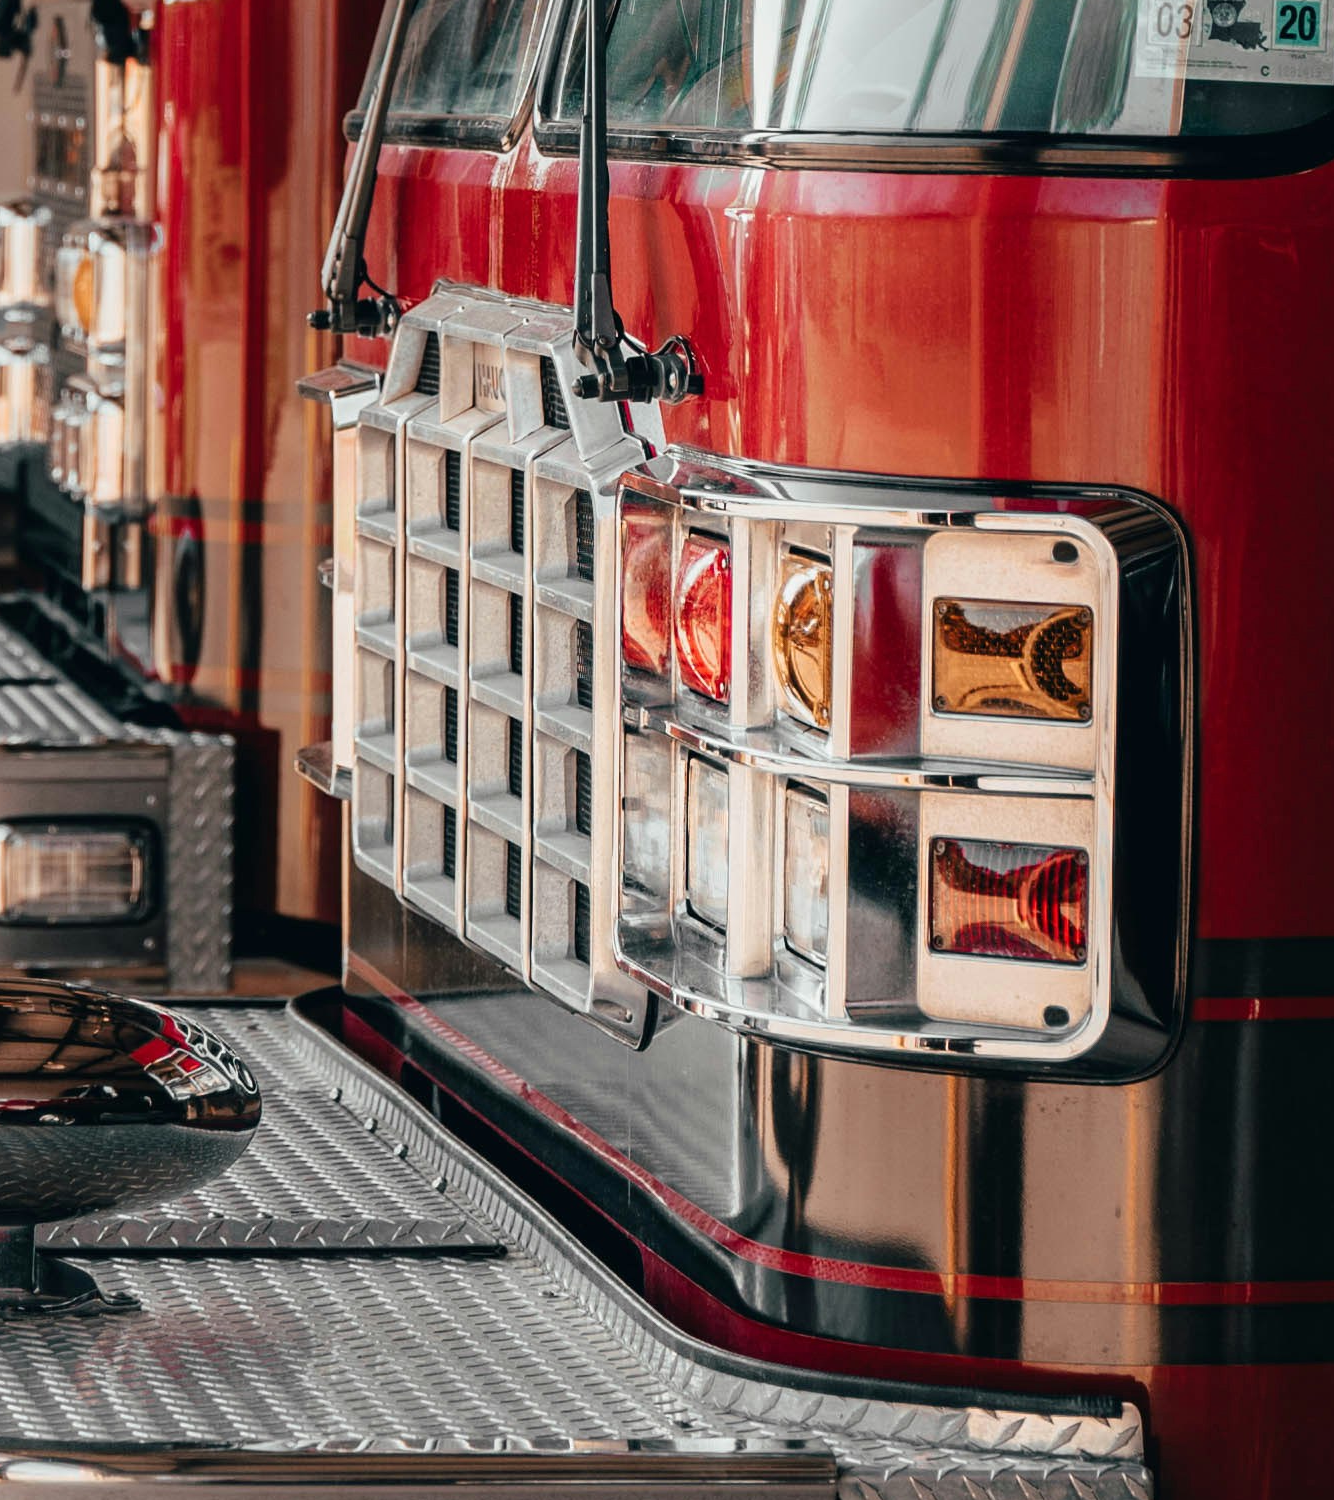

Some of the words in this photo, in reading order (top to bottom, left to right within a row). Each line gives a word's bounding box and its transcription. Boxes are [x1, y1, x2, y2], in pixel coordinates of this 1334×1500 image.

[1156, 2, 1193, 39] 03
[1279, 4, 1317, 41] 20
[1260, 65, 1271, 77] C
